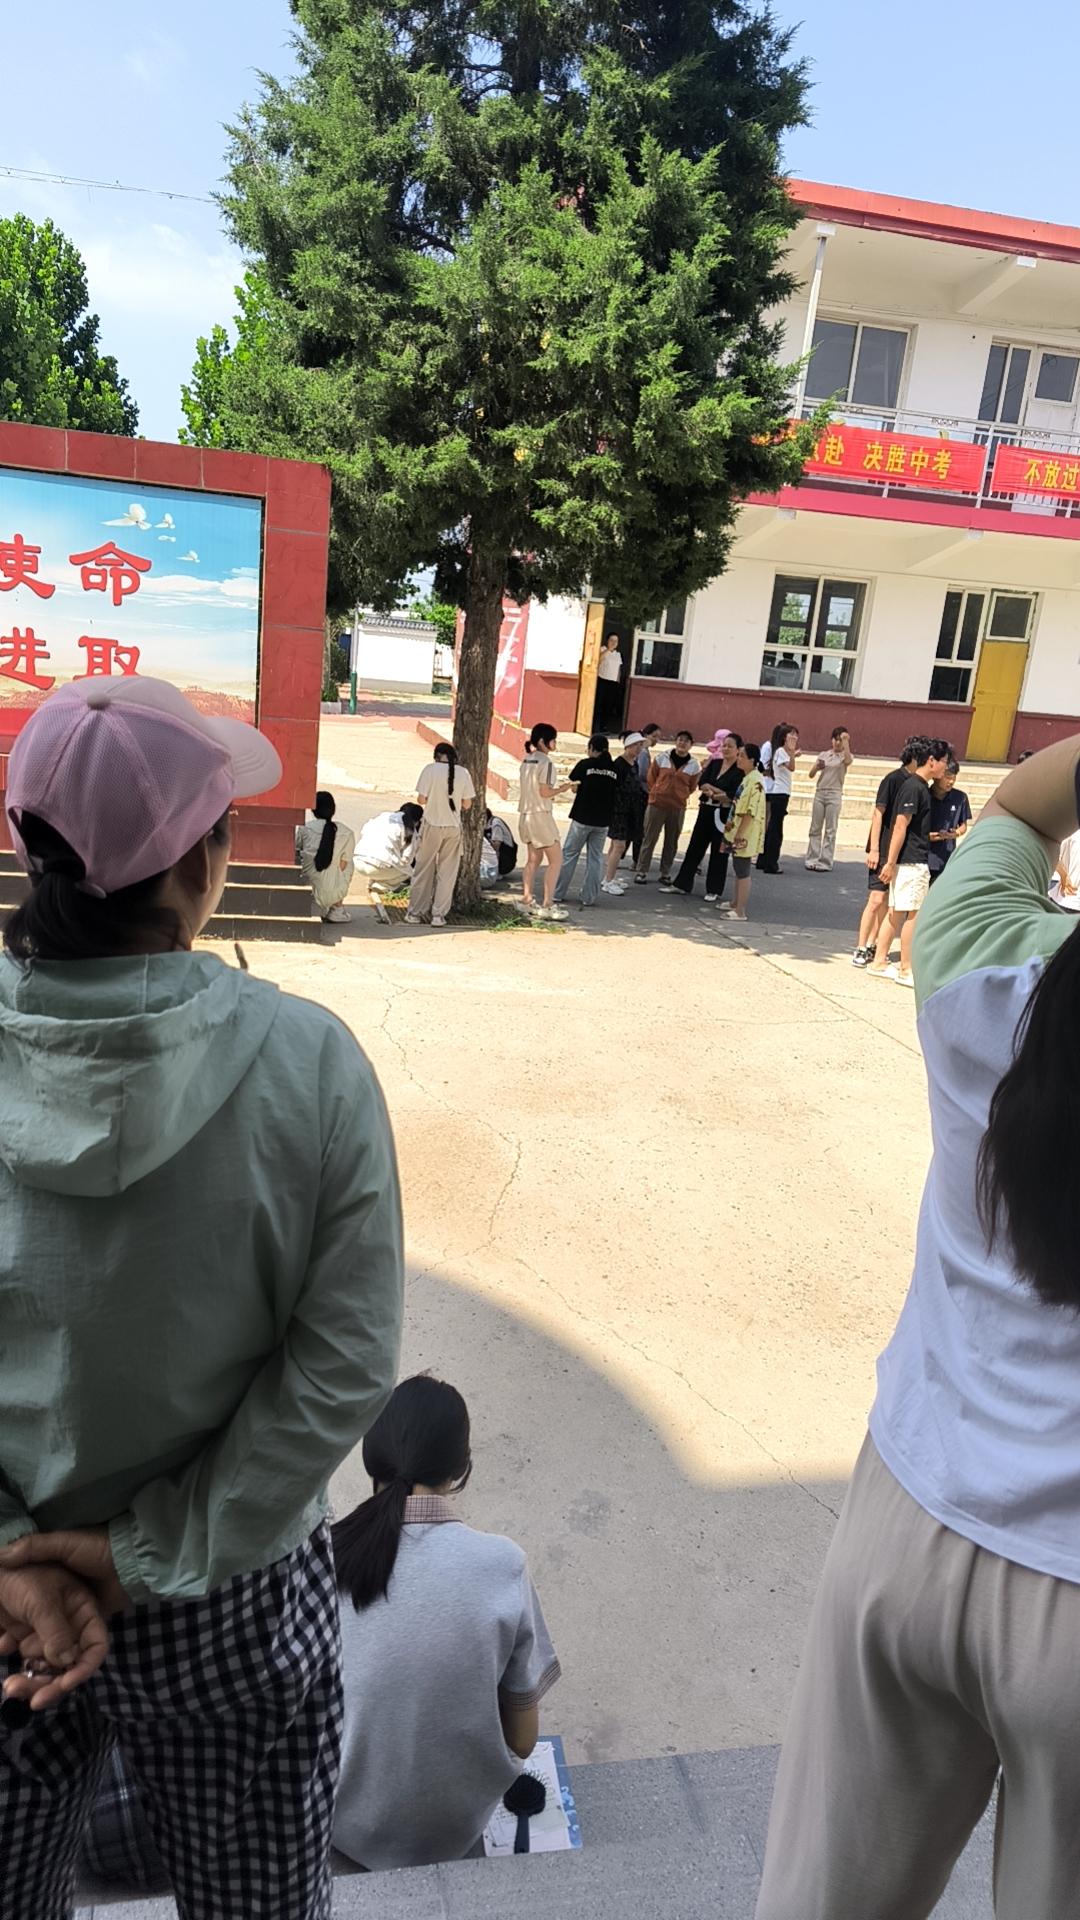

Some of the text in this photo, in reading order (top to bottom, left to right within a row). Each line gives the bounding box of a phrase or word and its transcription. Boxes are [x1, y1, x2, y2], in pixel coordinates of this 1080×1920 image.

[863, 441, 953, 480] 决胜中考
[1024, 459, 1080, 490] 不放过
